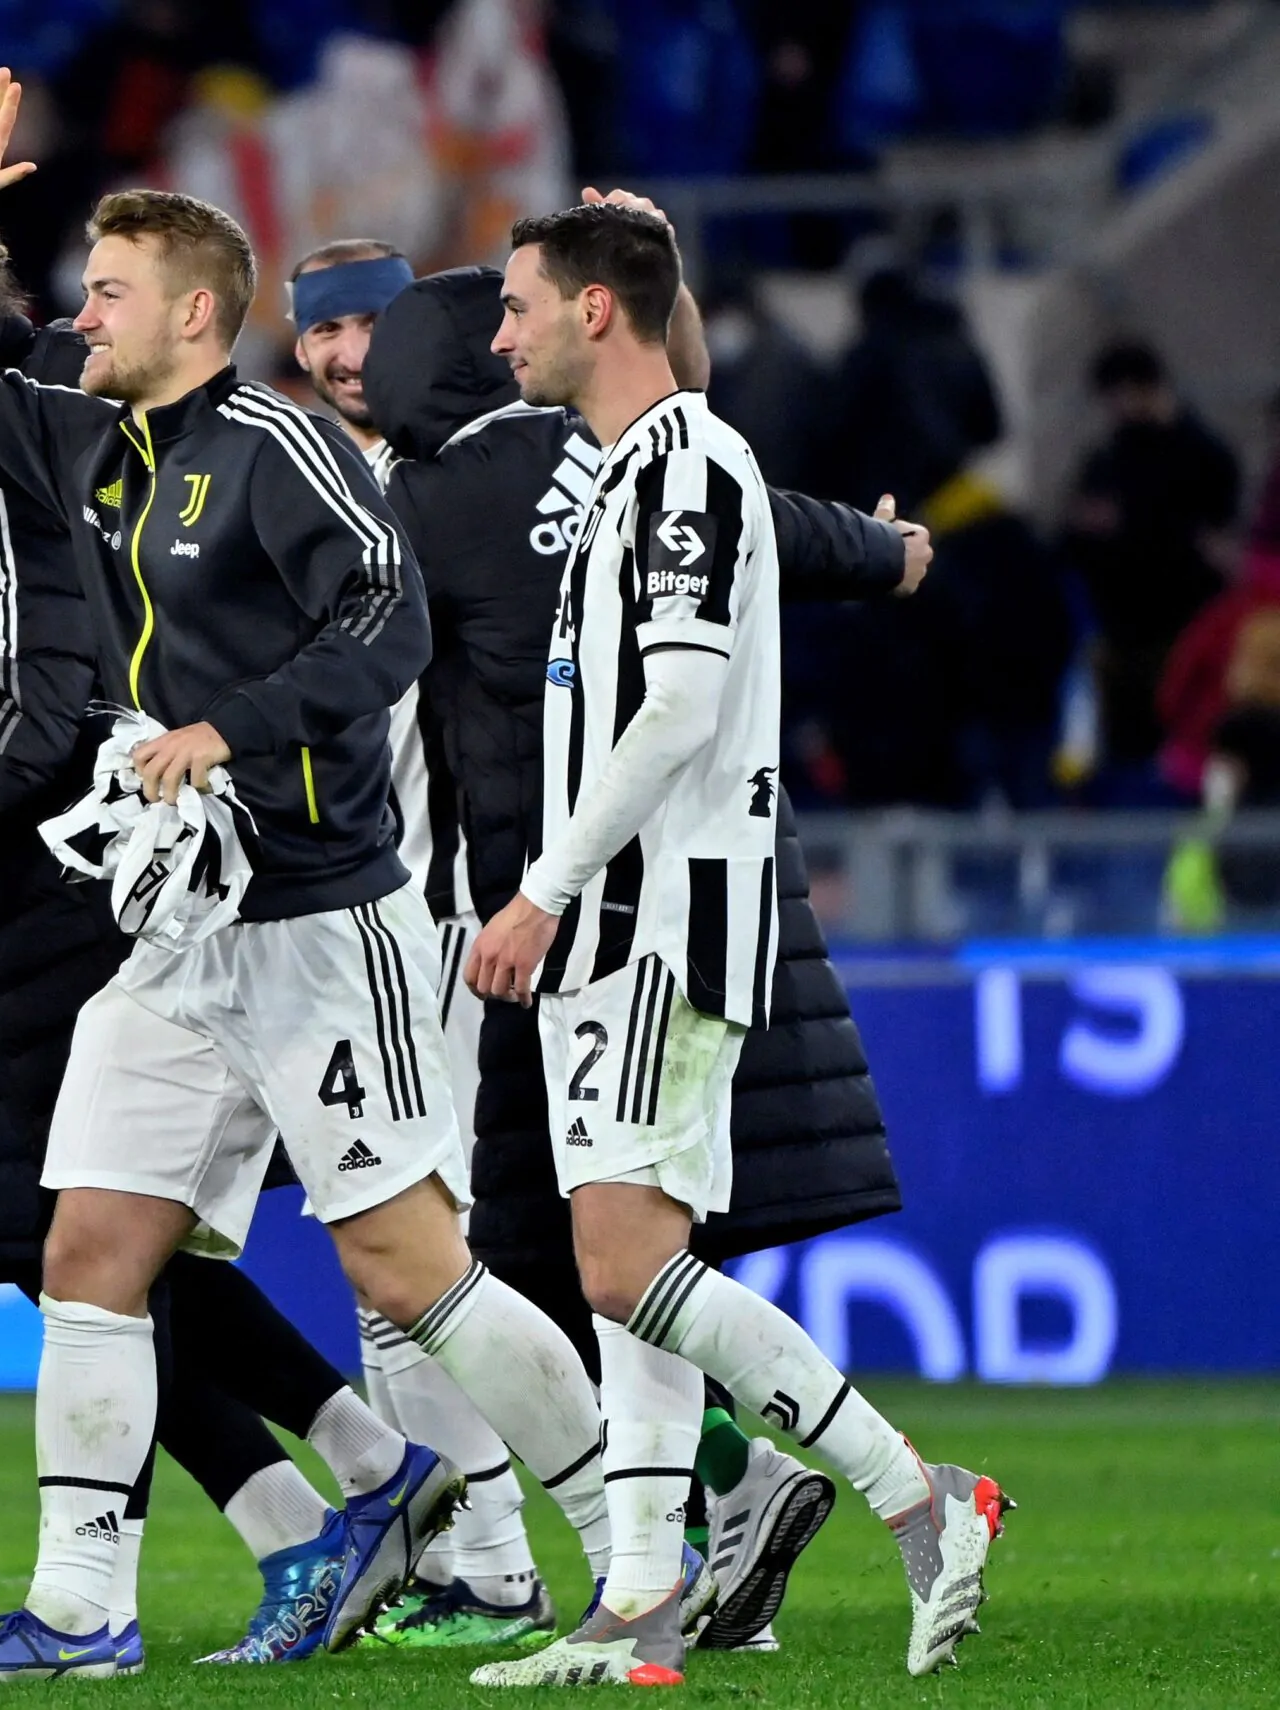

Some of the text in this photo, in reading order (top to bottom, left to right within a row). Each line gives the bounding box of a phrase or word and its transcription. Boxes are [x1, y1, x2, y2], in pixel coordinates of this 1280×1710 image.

[170, 539, 200, 559] Jeep
[646, 570, 709, 595] Bitget
[567, 1020, 609, 1102] 2
[317, 1039, 367, 1120] 4
[337, 1156, 383, 1172] adidas
